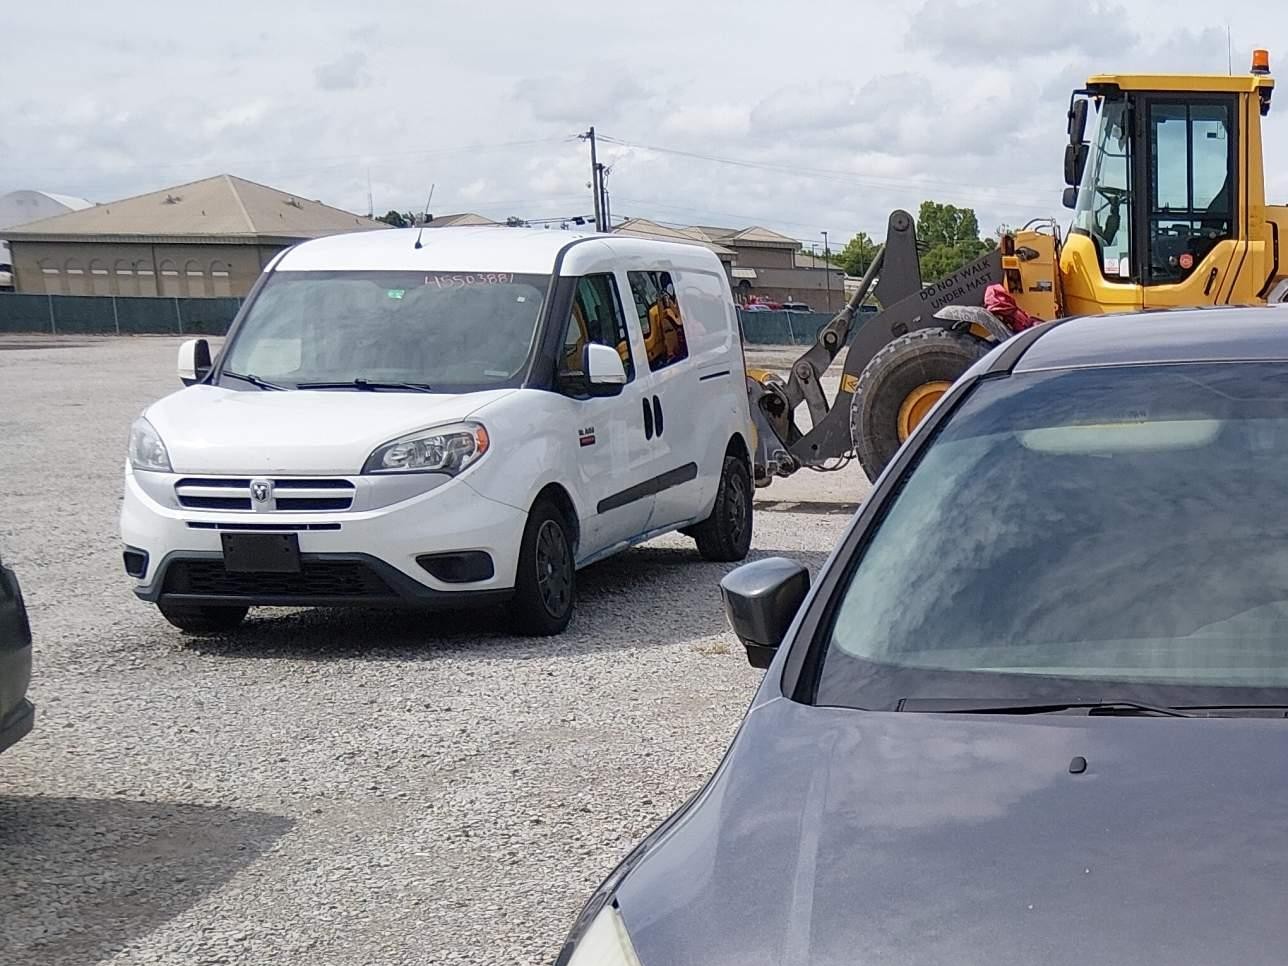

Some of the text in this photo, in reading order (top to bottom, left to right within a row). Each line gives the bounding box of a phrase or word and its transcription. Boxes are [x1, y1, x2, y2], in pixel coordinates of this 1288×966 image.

[919, 259, 992, 300] DO NOT WALK
[930, 272, 992, 309] UNDER MAST
